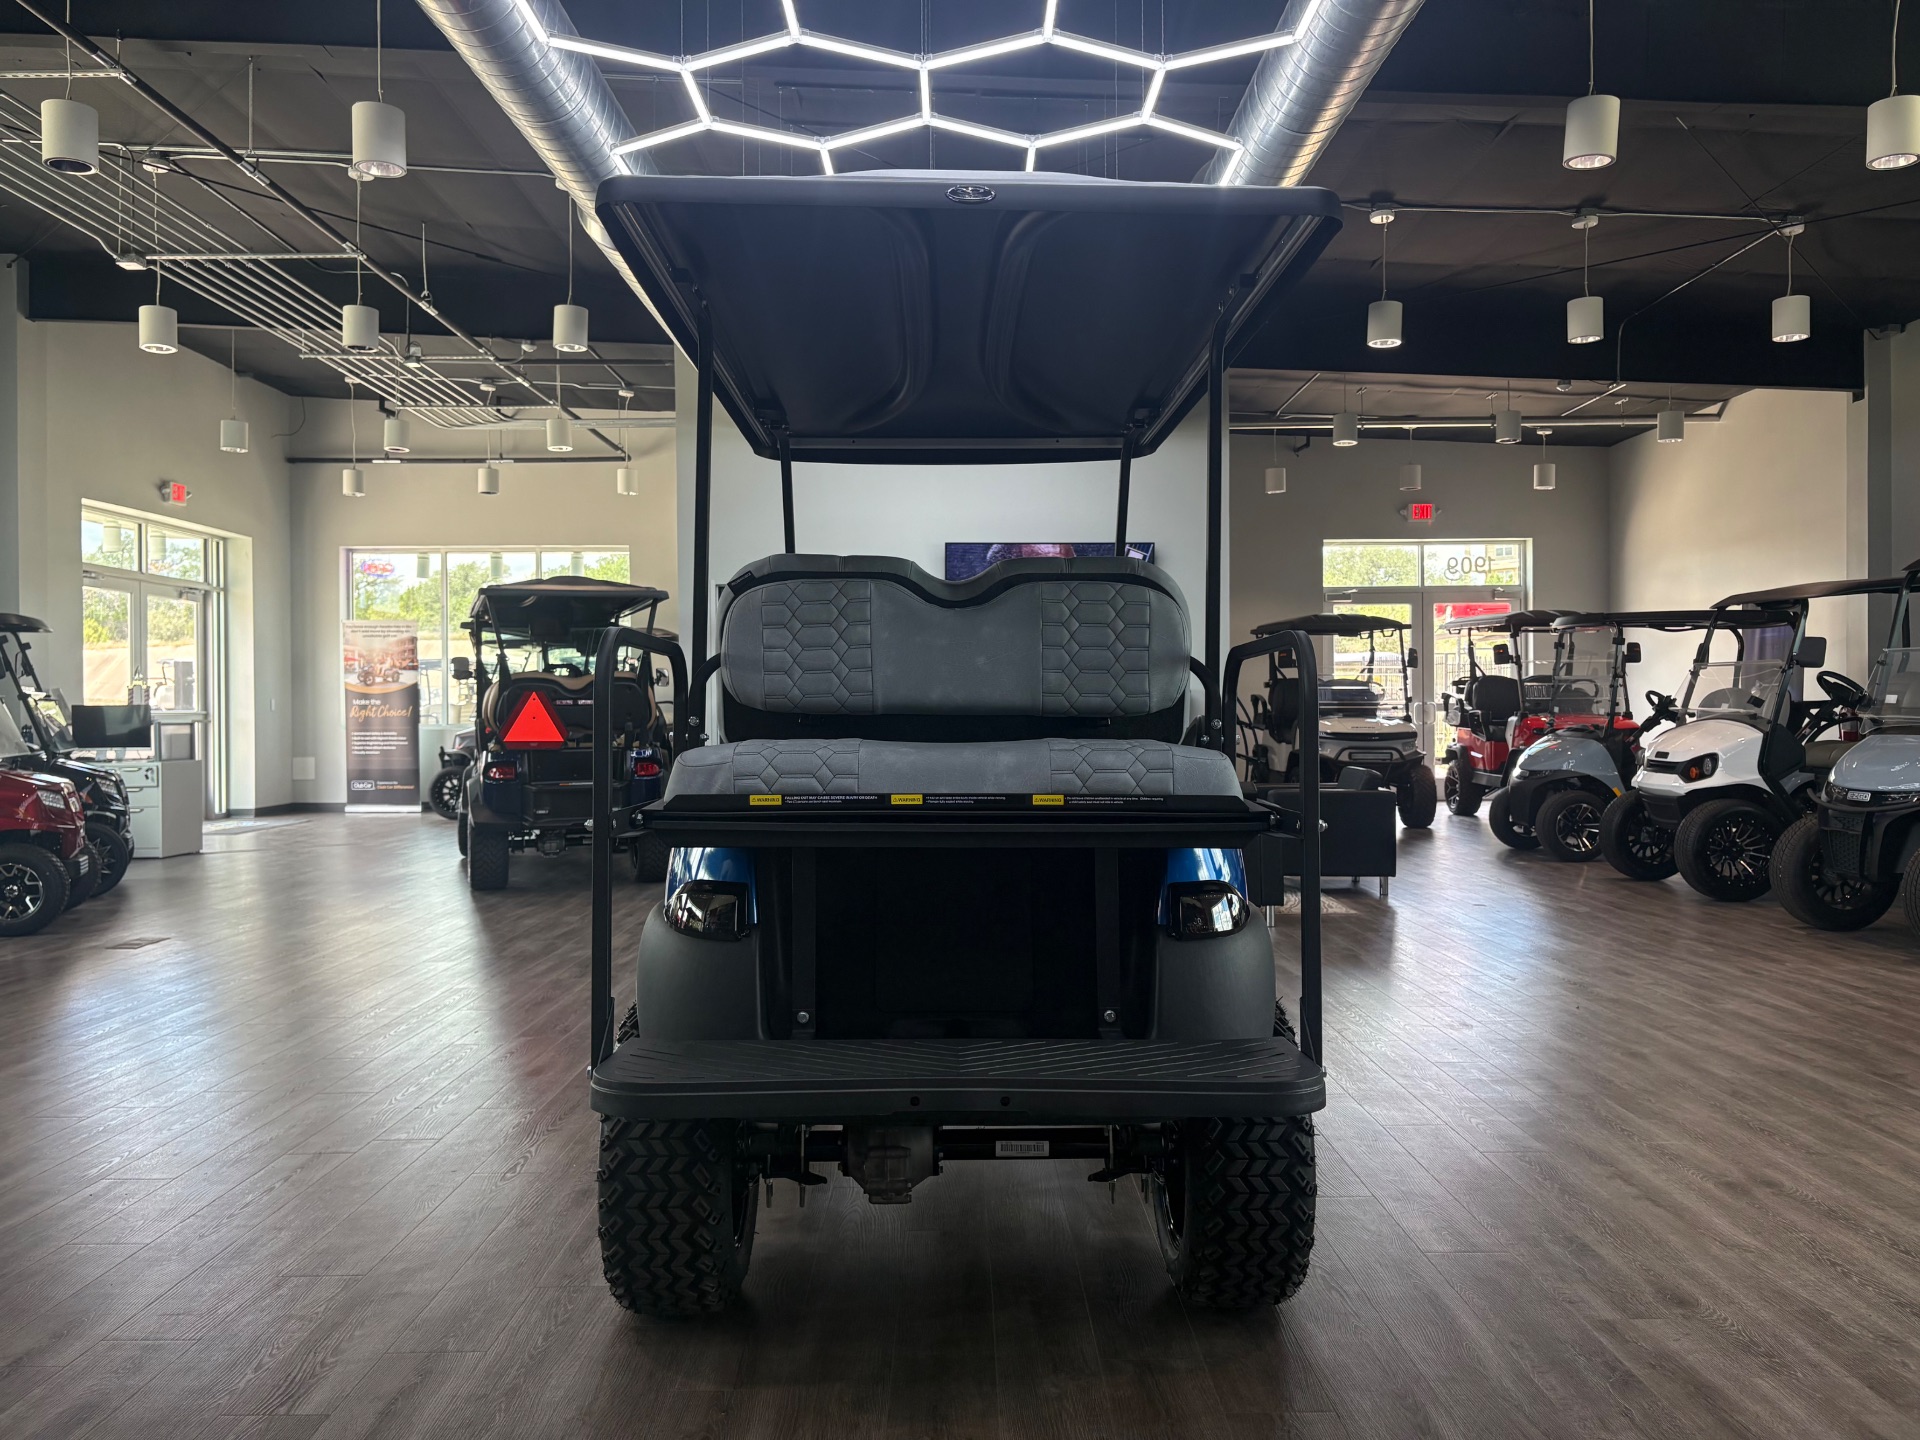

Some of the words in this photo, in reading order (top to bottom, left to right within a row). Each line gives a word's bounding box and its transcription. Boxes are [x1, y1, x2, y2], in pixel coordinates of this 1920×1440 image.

[1412, 504, 1432, 519] EXIT
[350, 705, 377, 722] Right
[378, 704, 413, 717] Choice!
